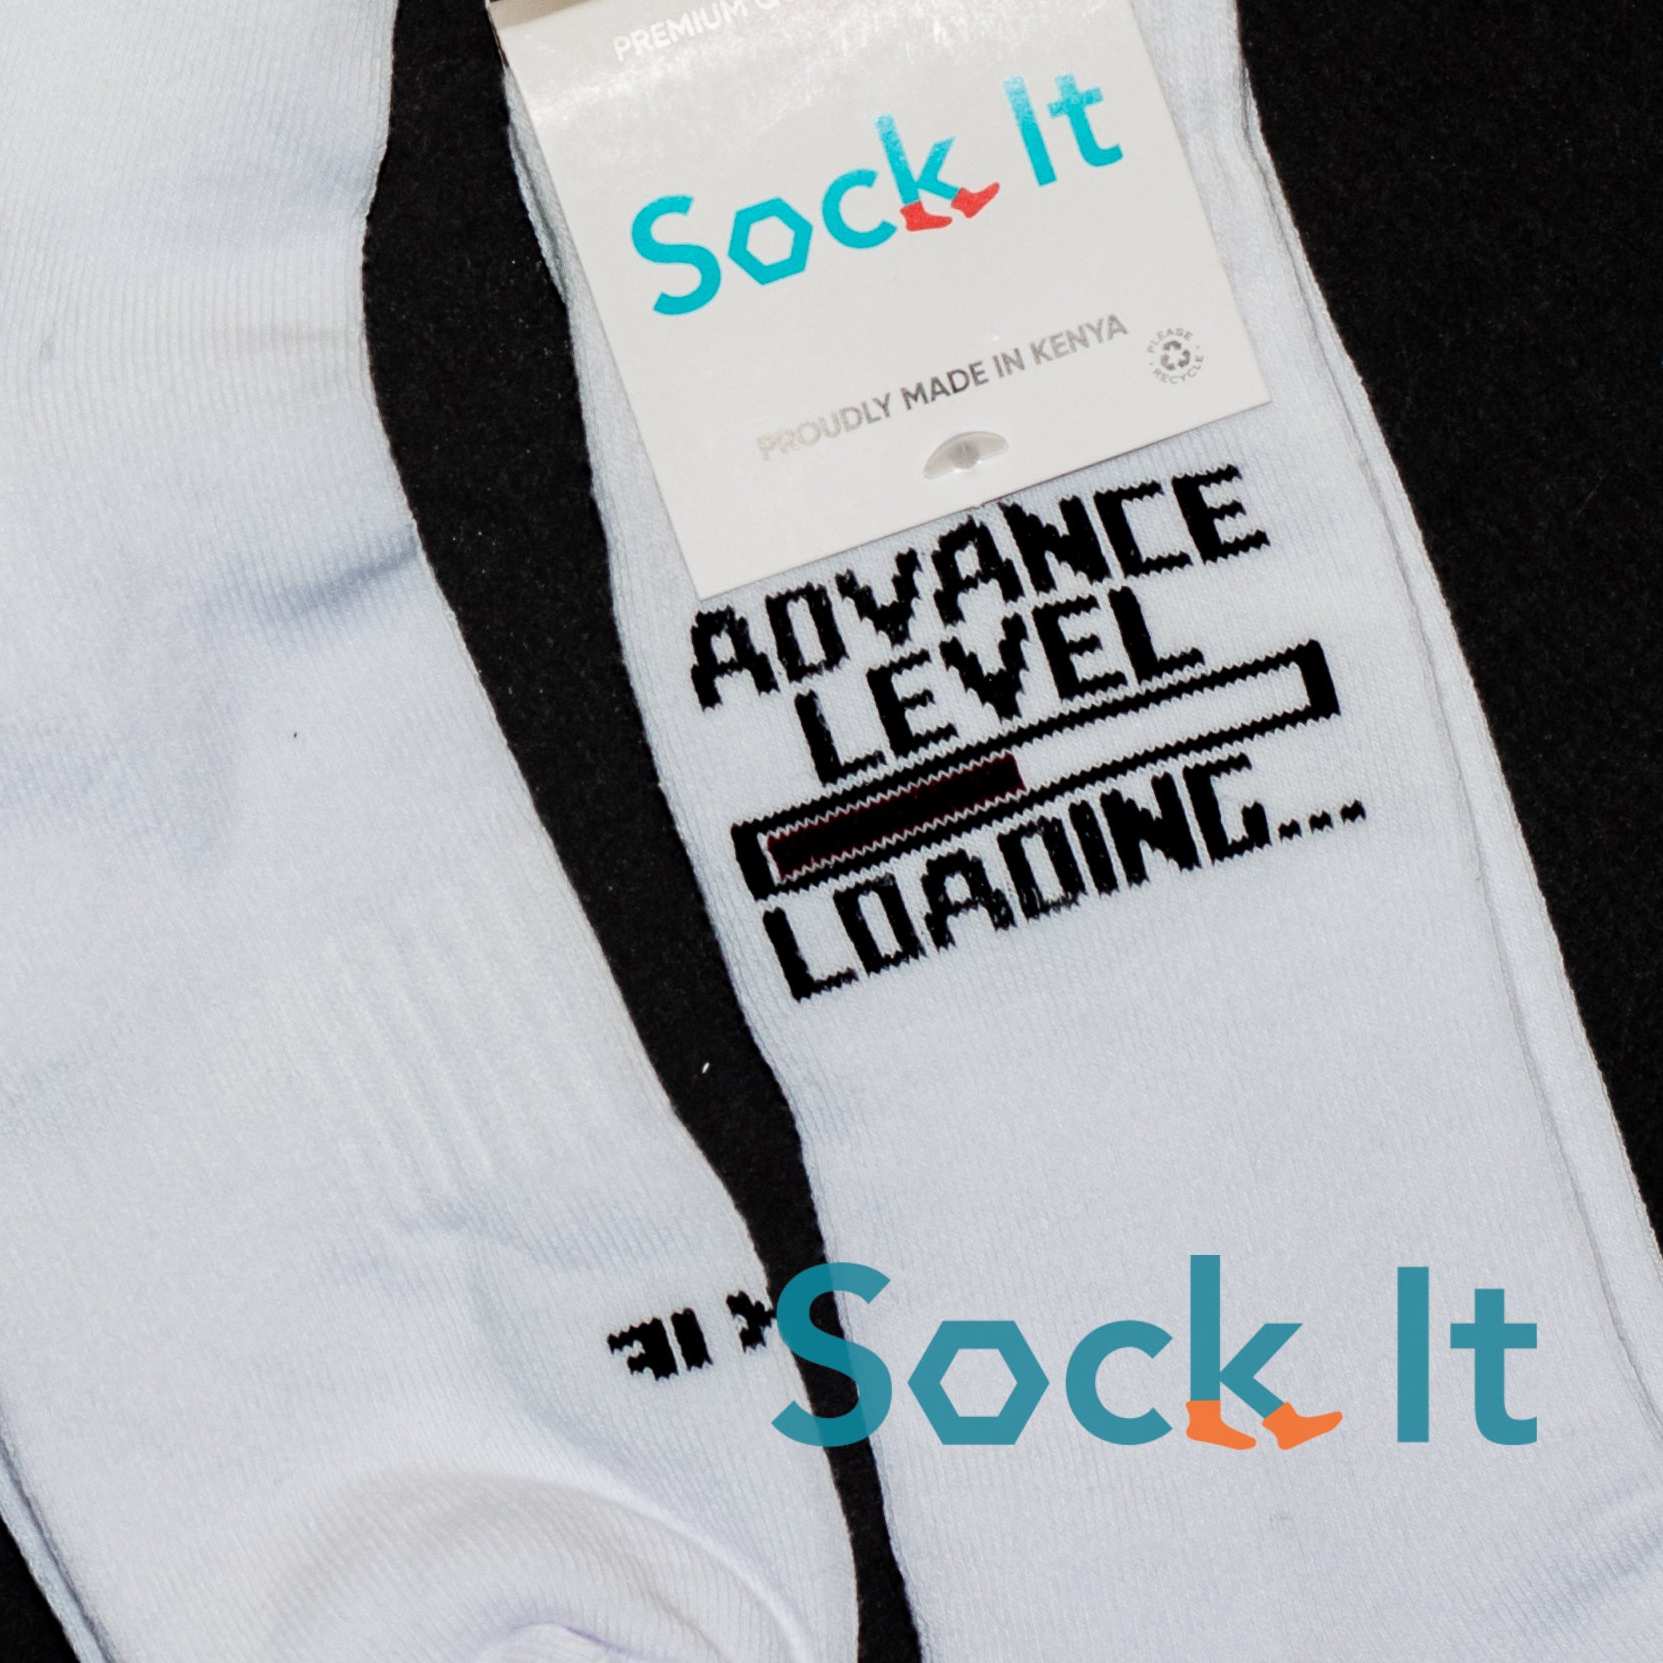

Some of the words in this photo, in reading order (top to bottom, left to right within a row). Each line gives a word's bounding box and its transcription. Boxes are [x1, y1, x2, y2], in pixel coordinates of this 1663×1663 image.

[630, 113, 1001, 317] Sock
[1002, 72, 1123, 187] It
[757, 394, 894, 462] PROUDLY
[900, 357, 990, 412] MADE
[991, 345, 1026, 376] IN
[1032, 313, 1130, 367] KENYA
[1147, 327, 1194, 354] PLEASE
[690, 465, 1269, 711] ADVANCE
[794, 586, 1204, 787] LEVEL
